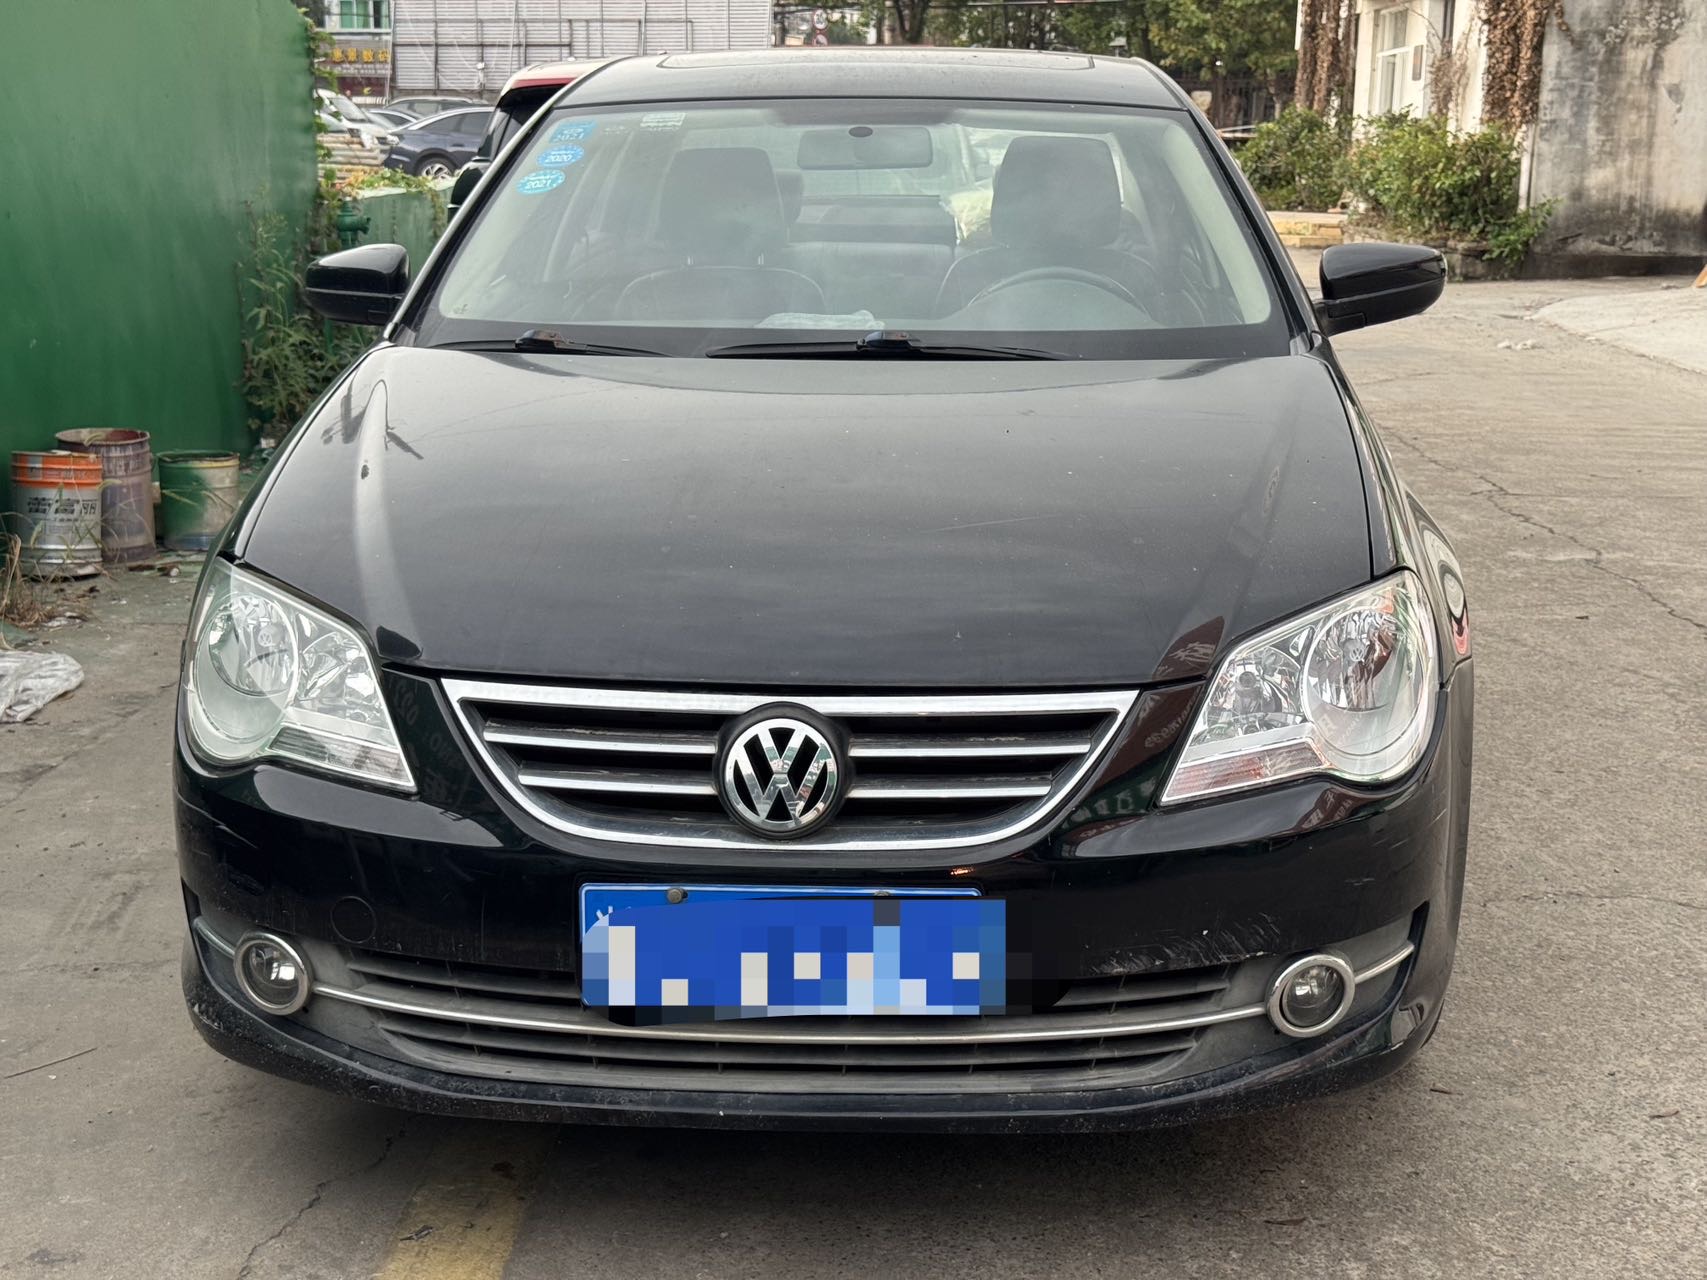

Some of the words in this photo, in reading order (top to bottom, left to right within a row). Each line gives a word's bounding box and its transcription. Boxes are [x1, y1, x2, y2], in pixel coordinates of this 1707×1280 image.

[544, 154, 573, 163] 2020
[524, 179, 552, 190] 2021
[725, 717, 839, 824] VW
